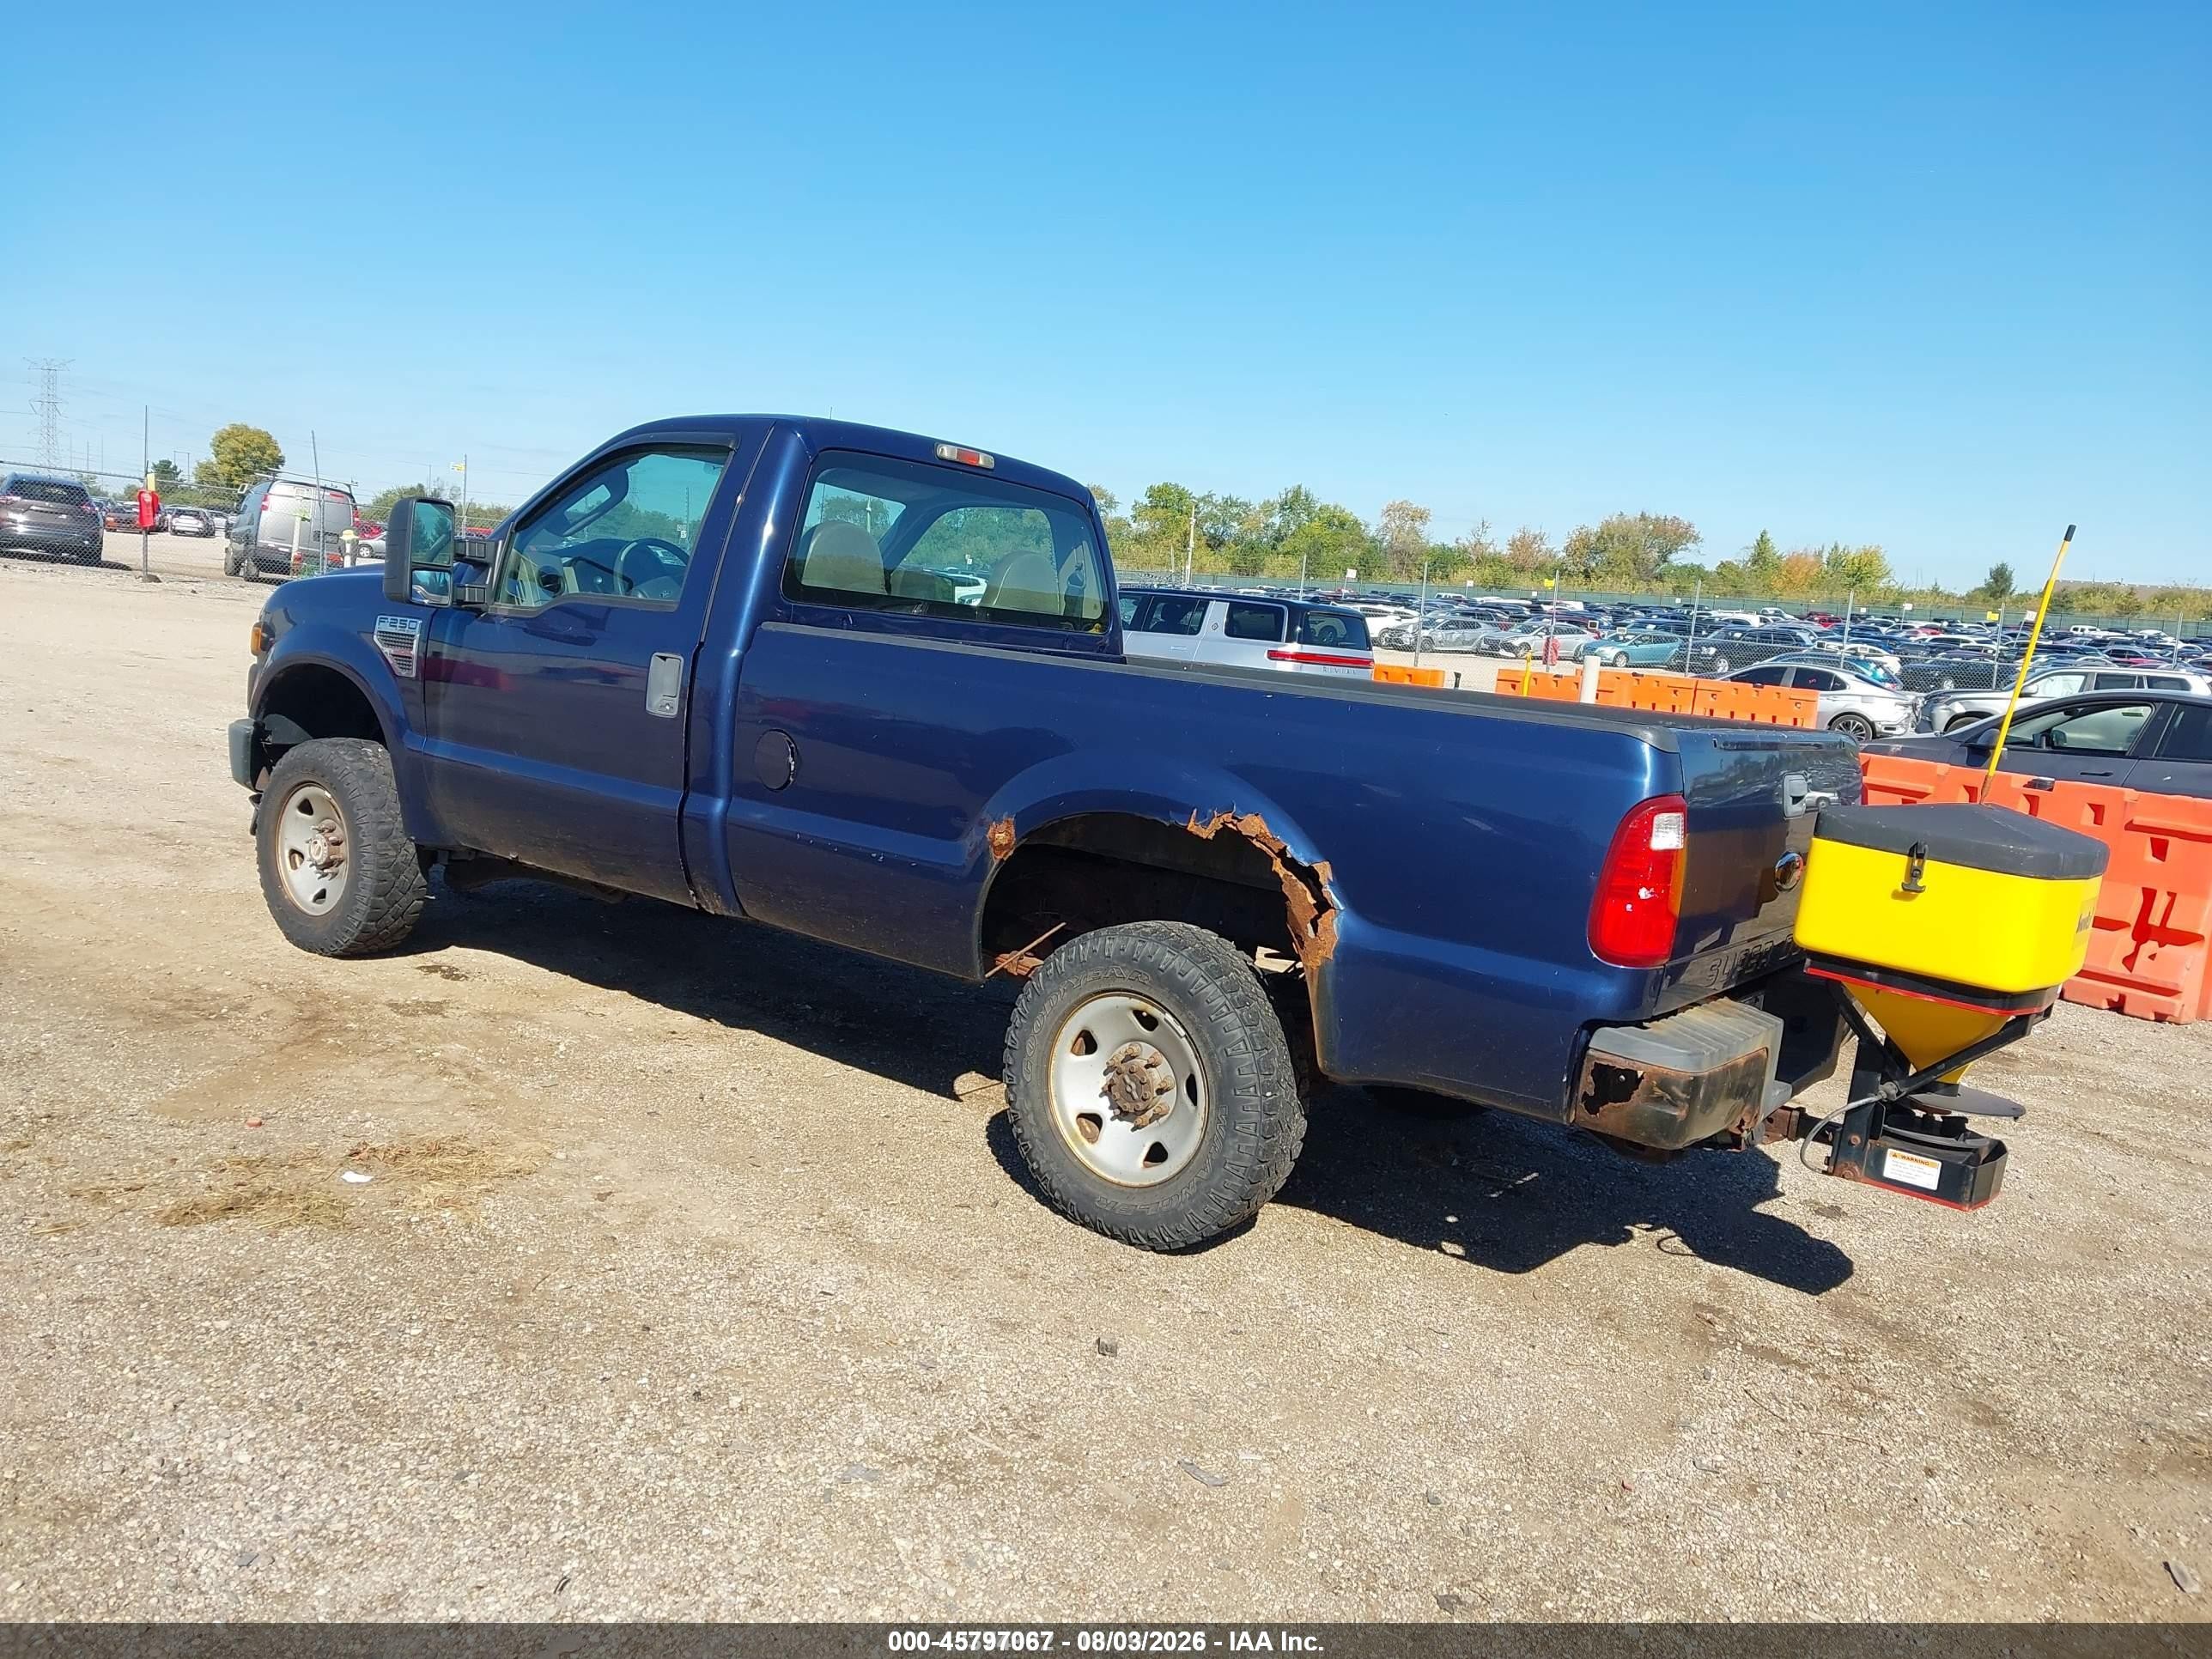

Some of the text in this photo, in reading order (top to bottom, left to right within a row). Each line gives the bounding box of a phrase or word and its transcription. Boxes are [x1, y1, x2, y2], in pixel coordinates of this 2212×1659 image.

[378, 616, 418, 630] F-250
[1022, 965, 1154, 1082] GOODYEAR
[1094, 1104, 1229, 1217] WRANGLER
[1900, 1154, 1929, 1166] WARNING
